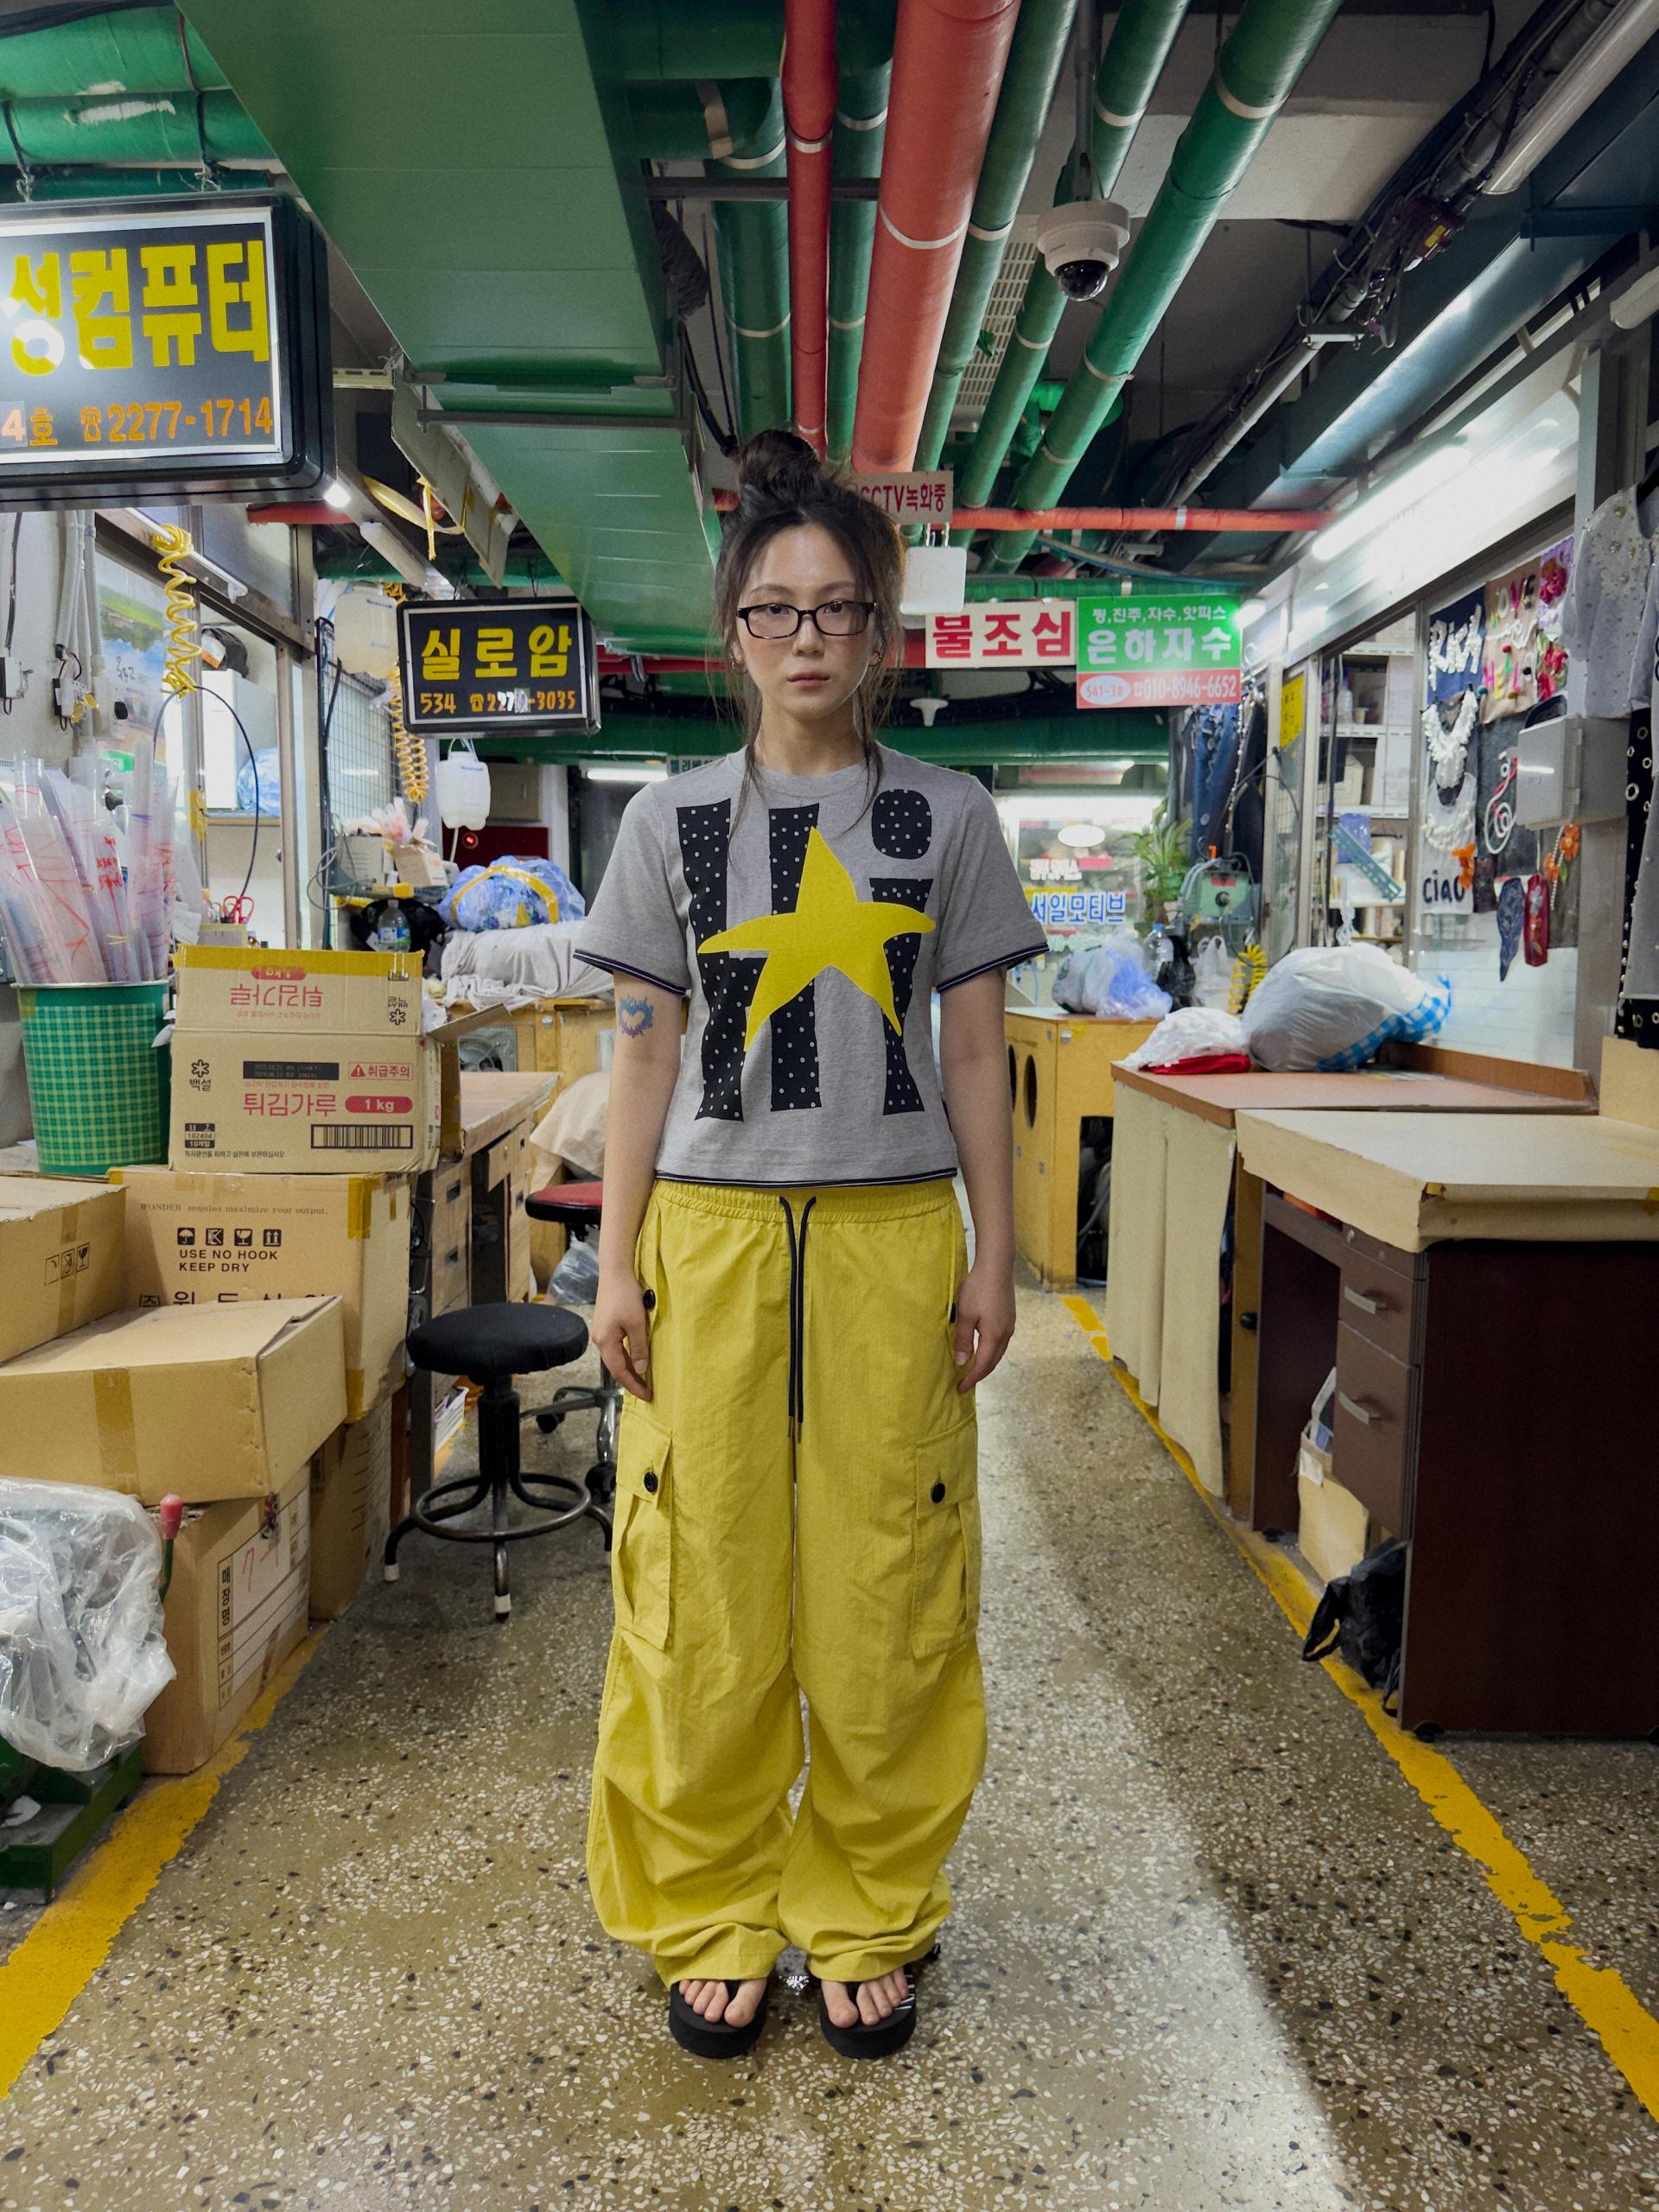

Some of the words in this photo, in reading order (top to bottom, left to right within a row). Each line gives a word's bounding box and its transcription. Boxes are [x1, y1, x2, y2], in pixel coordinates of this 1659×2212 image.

[9, 239, 270, 375] 성컴퓨터
[109, 397, 273, 442] 2277-1714
[932, 611, 1071, 659] 불조심
[1087, 626, 1231, 664] 은하자수
[421, 625, 572, 681] 실로암
[420, 692, 456, 715] 534
[486, 690, 575, 715] 227-3035
[1423, 869, 1465, 904] ciao
[230, 983, 324, 1007] 튀김가루
[367, 1065, 410, 1078] 취급주의
[189, 1078, 212, 1091] 백설
[243, 1093, 336, 1116] 튀김가루
[365, 1099, 371, 1110] 1
[376, 1099, 394, 1112] kg
[180, 1249, 207, 1259] USE
[213, 1250, 232, 1259] NO
[238, 1250, 277, 1260] HOOK
[179, 1262, 215, 1272] KEEP
[221, 1263, 250, 1272] DRY
